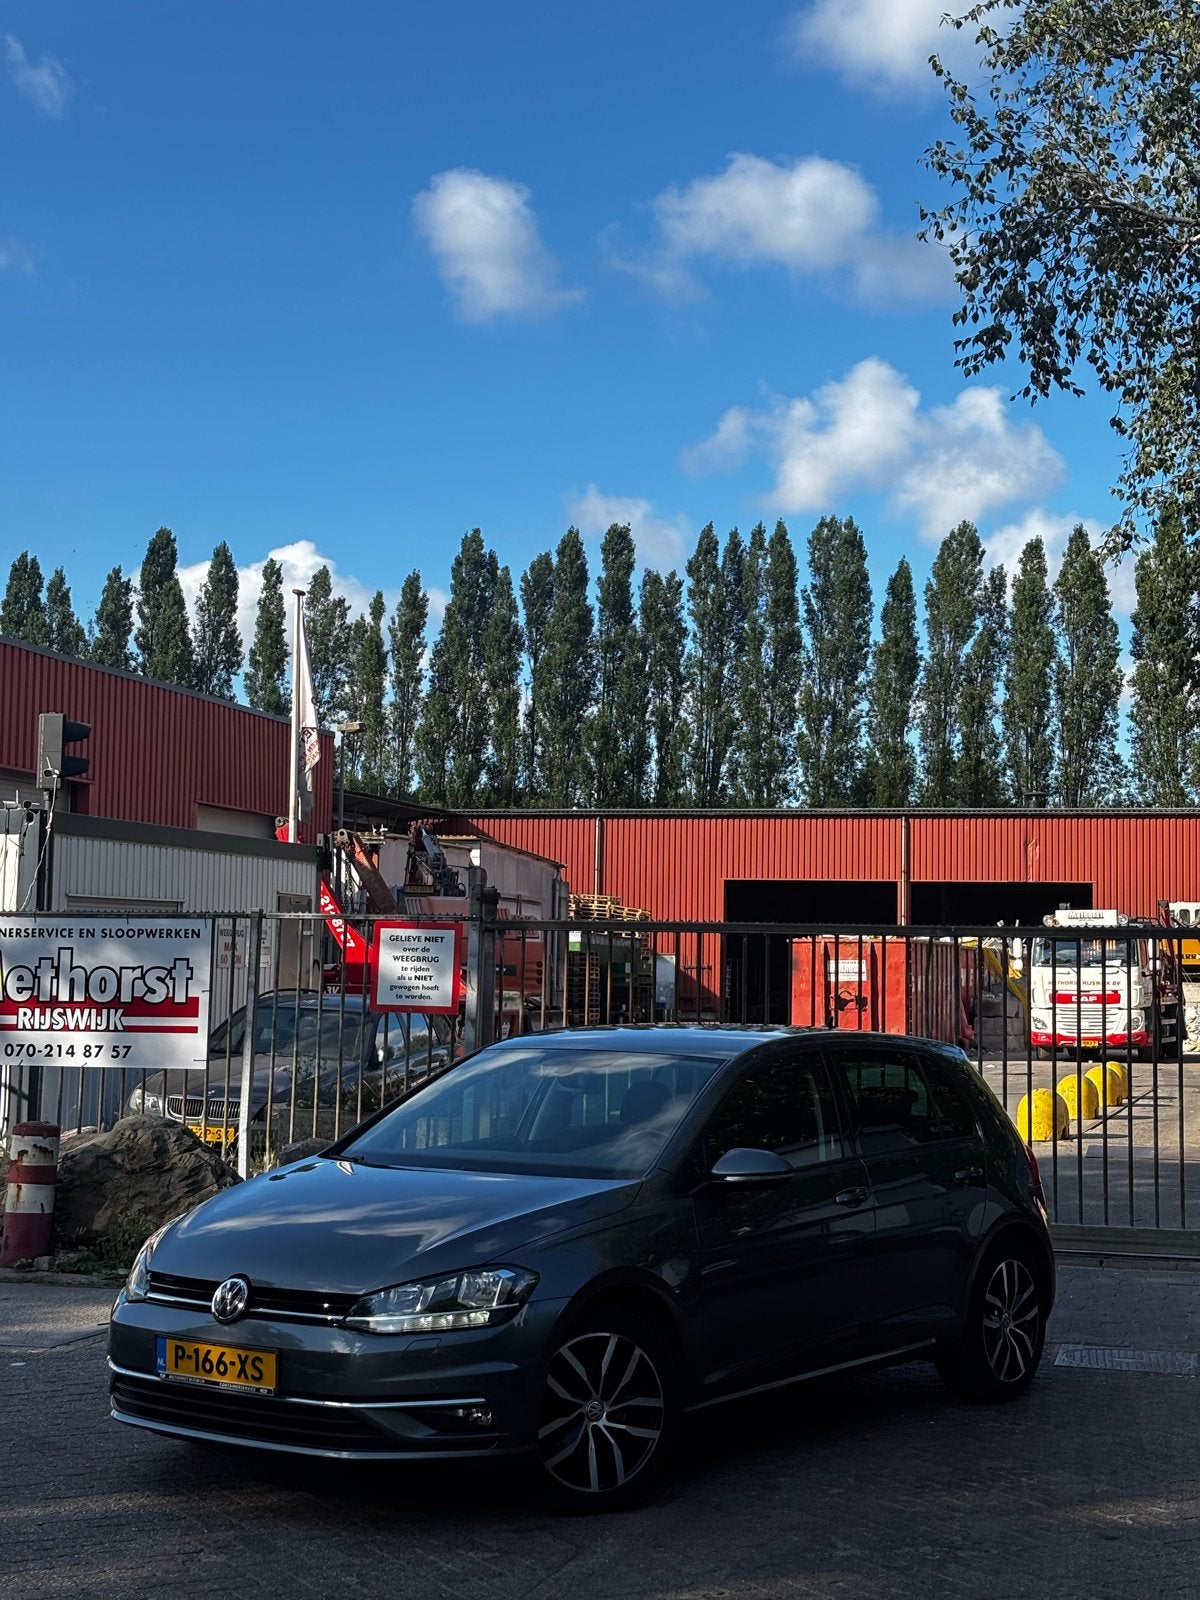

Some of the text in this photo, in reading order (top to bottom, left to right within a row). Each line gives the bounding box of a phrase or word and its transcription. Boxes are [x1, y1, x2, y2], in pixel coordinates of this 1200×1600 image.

[79, 928, 96, 938] EN
[101, 928, 201, 939] SLOOPWERKEN
[393, 955, 439, 963] WEEGBRUG
[0, 947, 193, 1004] ethorst
[410, 965, 430, 973] rijden
[17, 1007, 124, 1031] RIJSWIJK
[5, 1043, 132, 1059] 070-214 87 57
[157, 1344, 264, 1382] NL P-166-XS
